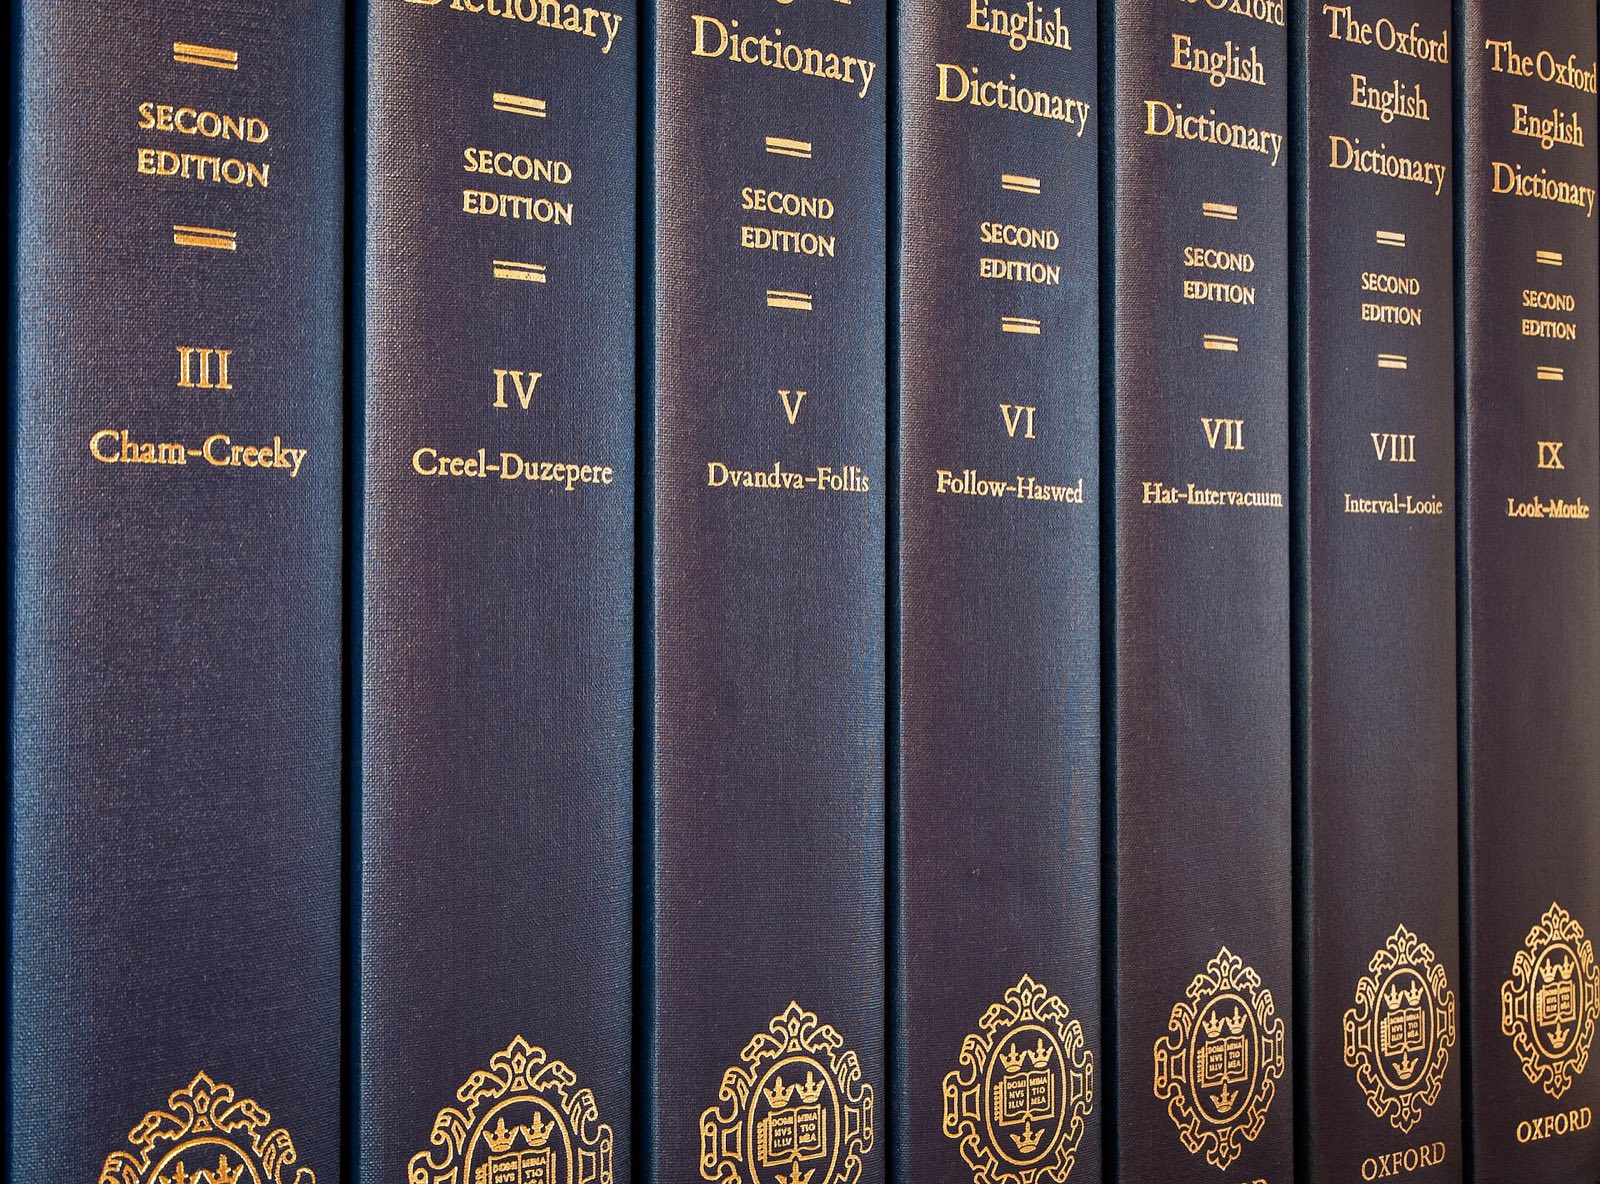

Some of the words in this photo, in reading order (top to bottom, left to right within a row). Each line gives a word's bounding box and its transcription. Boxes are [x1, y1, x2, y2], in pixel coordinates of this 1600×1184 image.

[966, 0, 1071, 51] English
[1323, 4, 1372, 45] The
[1376, 18, 1448, 63] Oxford
[691, 15, 876, 98] Dictionary
[1171, 34, 1265, 87] English
[1485, 39, 1533, 76] The
[1536, 51, 1597, 93] Oxford
[936, 63, 1088, 136] Dictionary
[1351, 74, 1430, 123] English
[138, 102, 268, 144] SECOND
[1144, 100, 1282, 164] Dictionary
[1512, 104, 1584, 150] English
[137, 148, 269, 187] EDITION
[464, 147, 572, 184] SECOND
[1329, 136, 1446, 195] Dictionary
[463, 190, 573, 224] EDITION
[742, 187, 833, 219] SECOND
[1492, 162, 1595, 218] Dictionary
[742, 225, 835, 256] EDITION
[981, 222, 1058, 250] SECOND
[980, 258, 1059, 283] EDITION
[1184, 247, 1254, 272] SECOND
[1184, 281, 1255, 303] EDITION
[1362, 272, 1420, 295] SECOND
[1523, 290, 1575, 311] SECOND
[1362, 303, 1422, 326] EDITION
[1522, 319, 1576, 340] EDITION
[176, 346, 232, 389] III
[493, 369, 542, 409] IV
[779, 389, 806, 424] V
[1000, 404, 1036, 438] VI
[1201, 418, 1243, 450] VII
[1371, 433, 1416, 462] VIII
[1537, 441, 1564, 469] IX
[1229, 1051, 1240, 1059] TIO
[1007, 1081, 1026, 1089] DOMI
[1009, 1090, 1024, 1098] NVS
[1031, 1096, 1046, 1105] MEA
[1032, 1087, 1045, 1095] TIO
[800, 1124, 815, 1132] TIO
[1517, 1107, 1591, 1142] OXFORD
[1362, 1142, 1445, 1180] OXFORD
